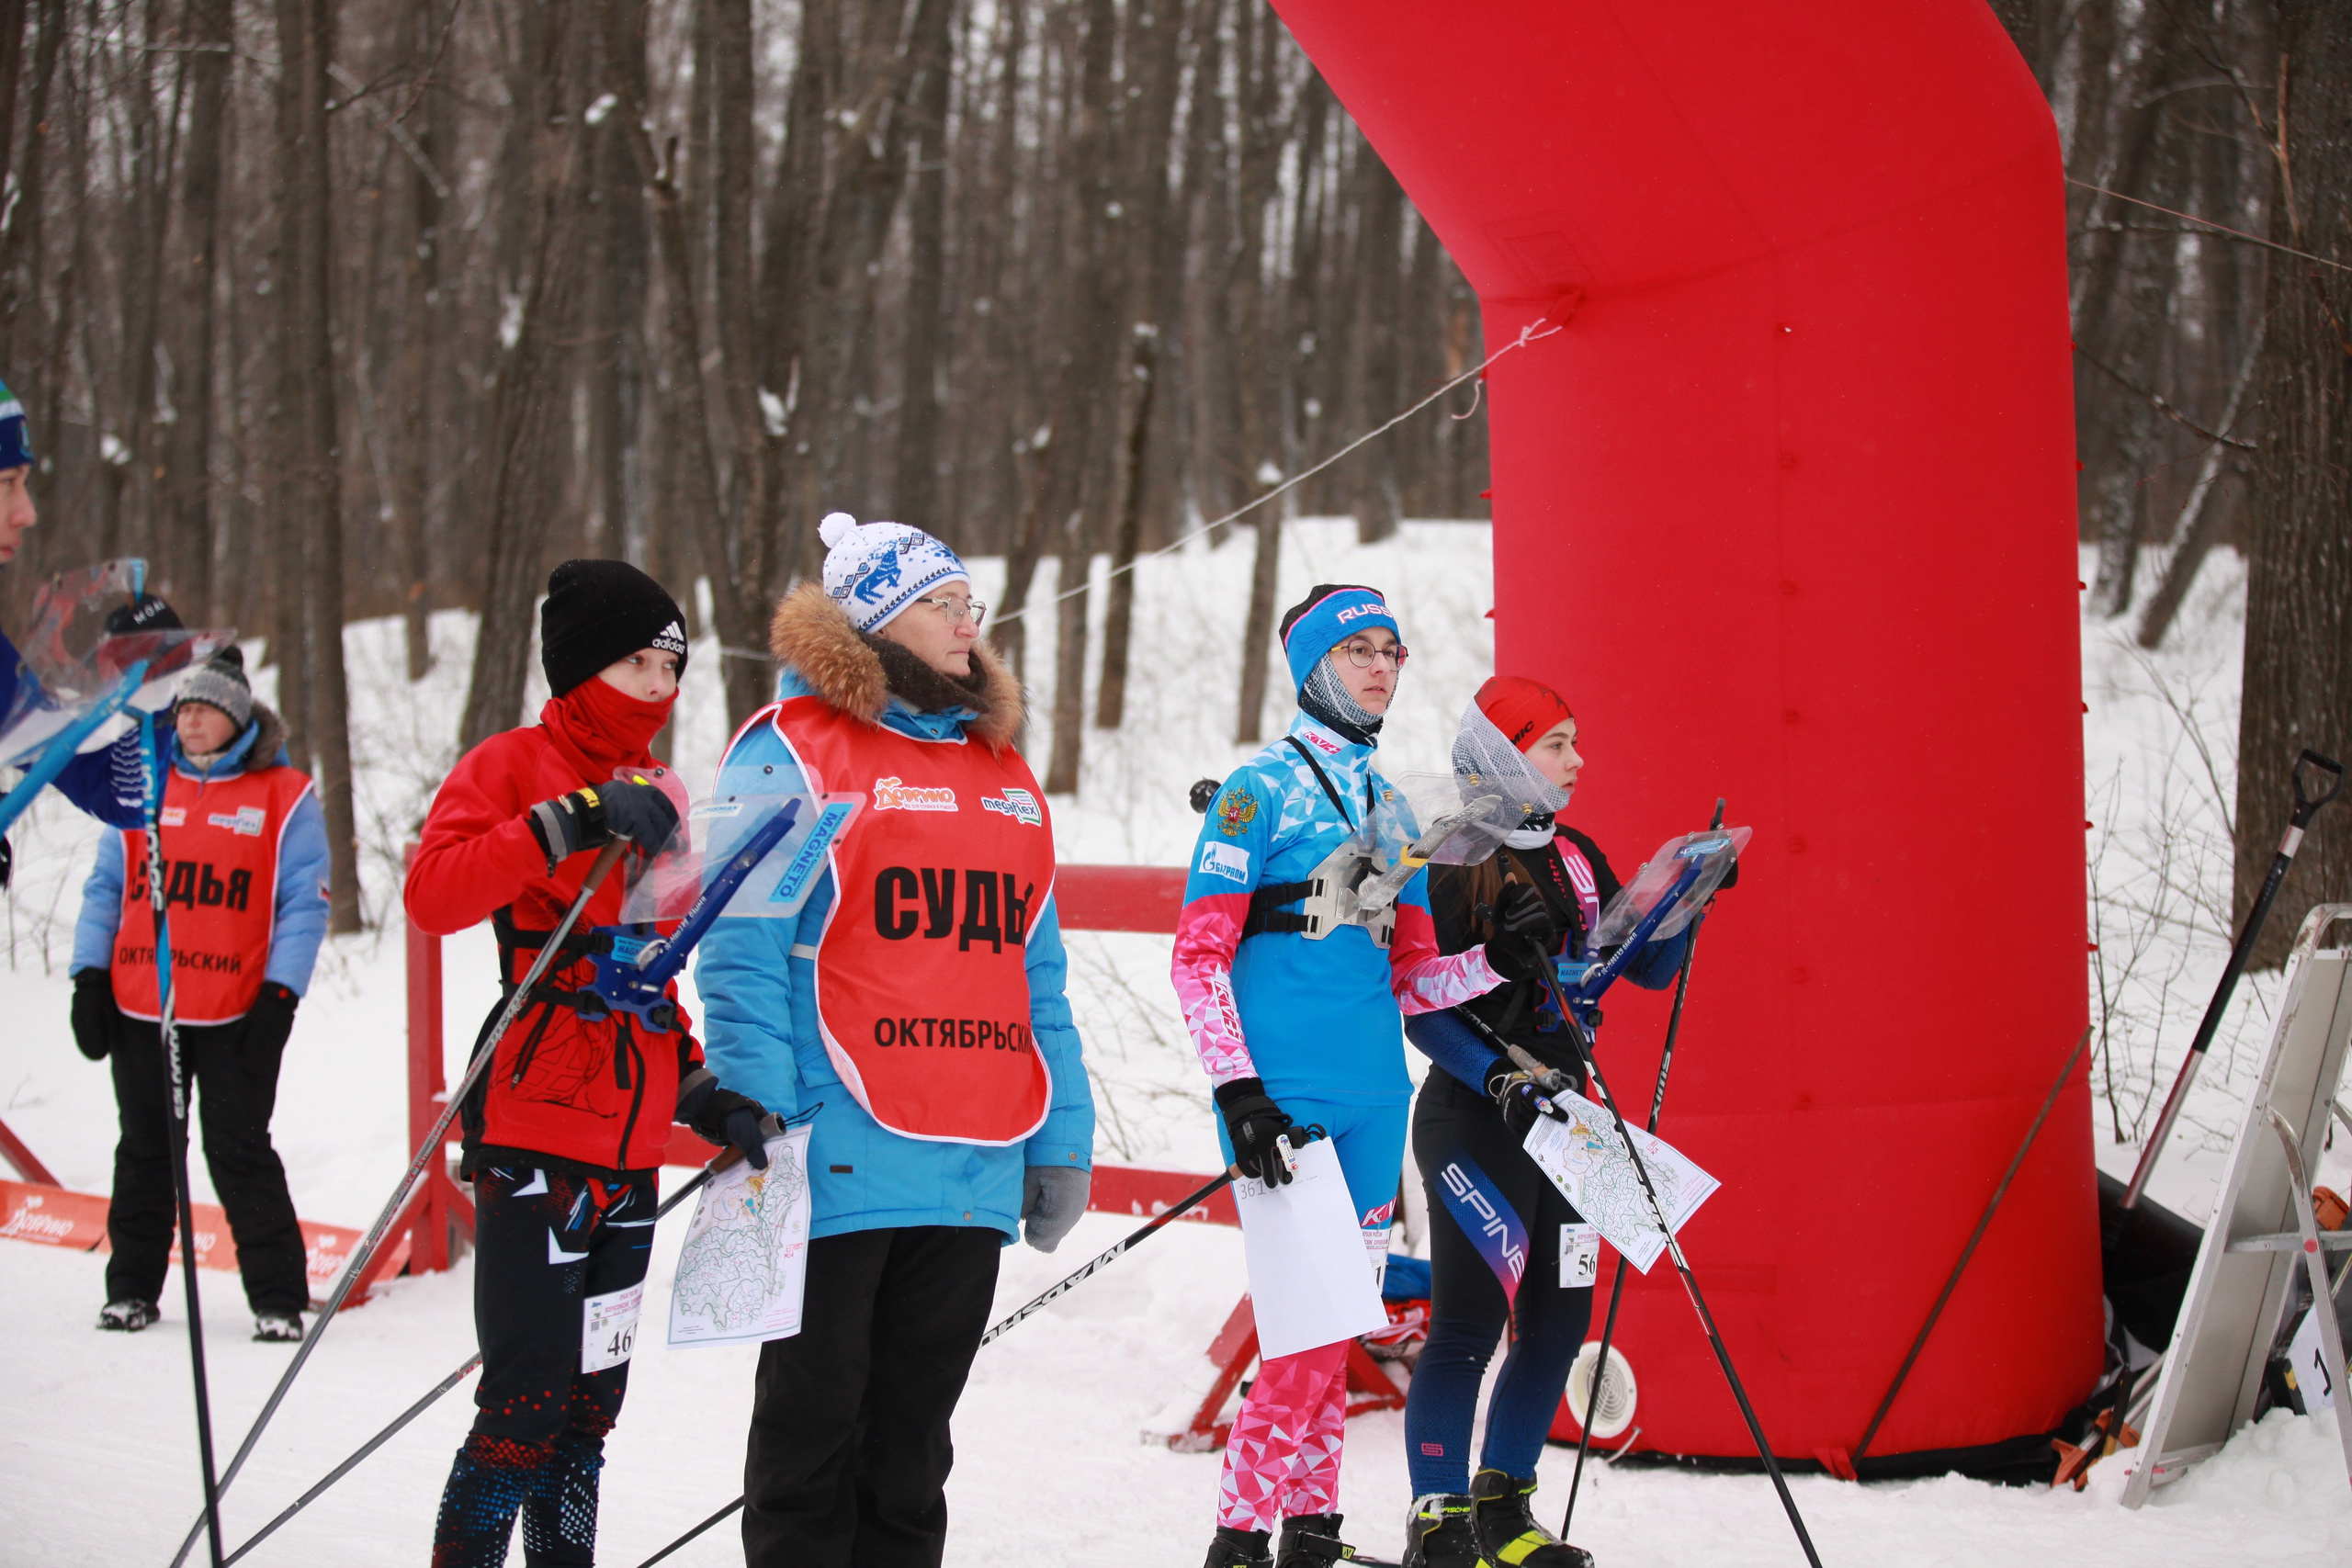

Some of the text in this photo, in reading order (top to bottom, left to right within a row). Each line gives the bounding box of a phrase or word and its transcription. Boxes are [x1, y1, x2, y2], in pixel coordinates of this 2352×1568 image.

[652, 637, 685, 654] adidas
[982, 796, 1038, 818] megaflex
[780, 812, 838, 897] MAGNETO
[130, 860, 252, 911] СДЬЯ
[119, 947, 242, 975] ОКТЯРЬСКИЙ
[1239, 1179, 1266, 1200] 361
[1441, 1163, 1525, 1283] SPINE
[1578, 1253, 1599, 1276] 56
[607, 1323, 639, 1357] 46
